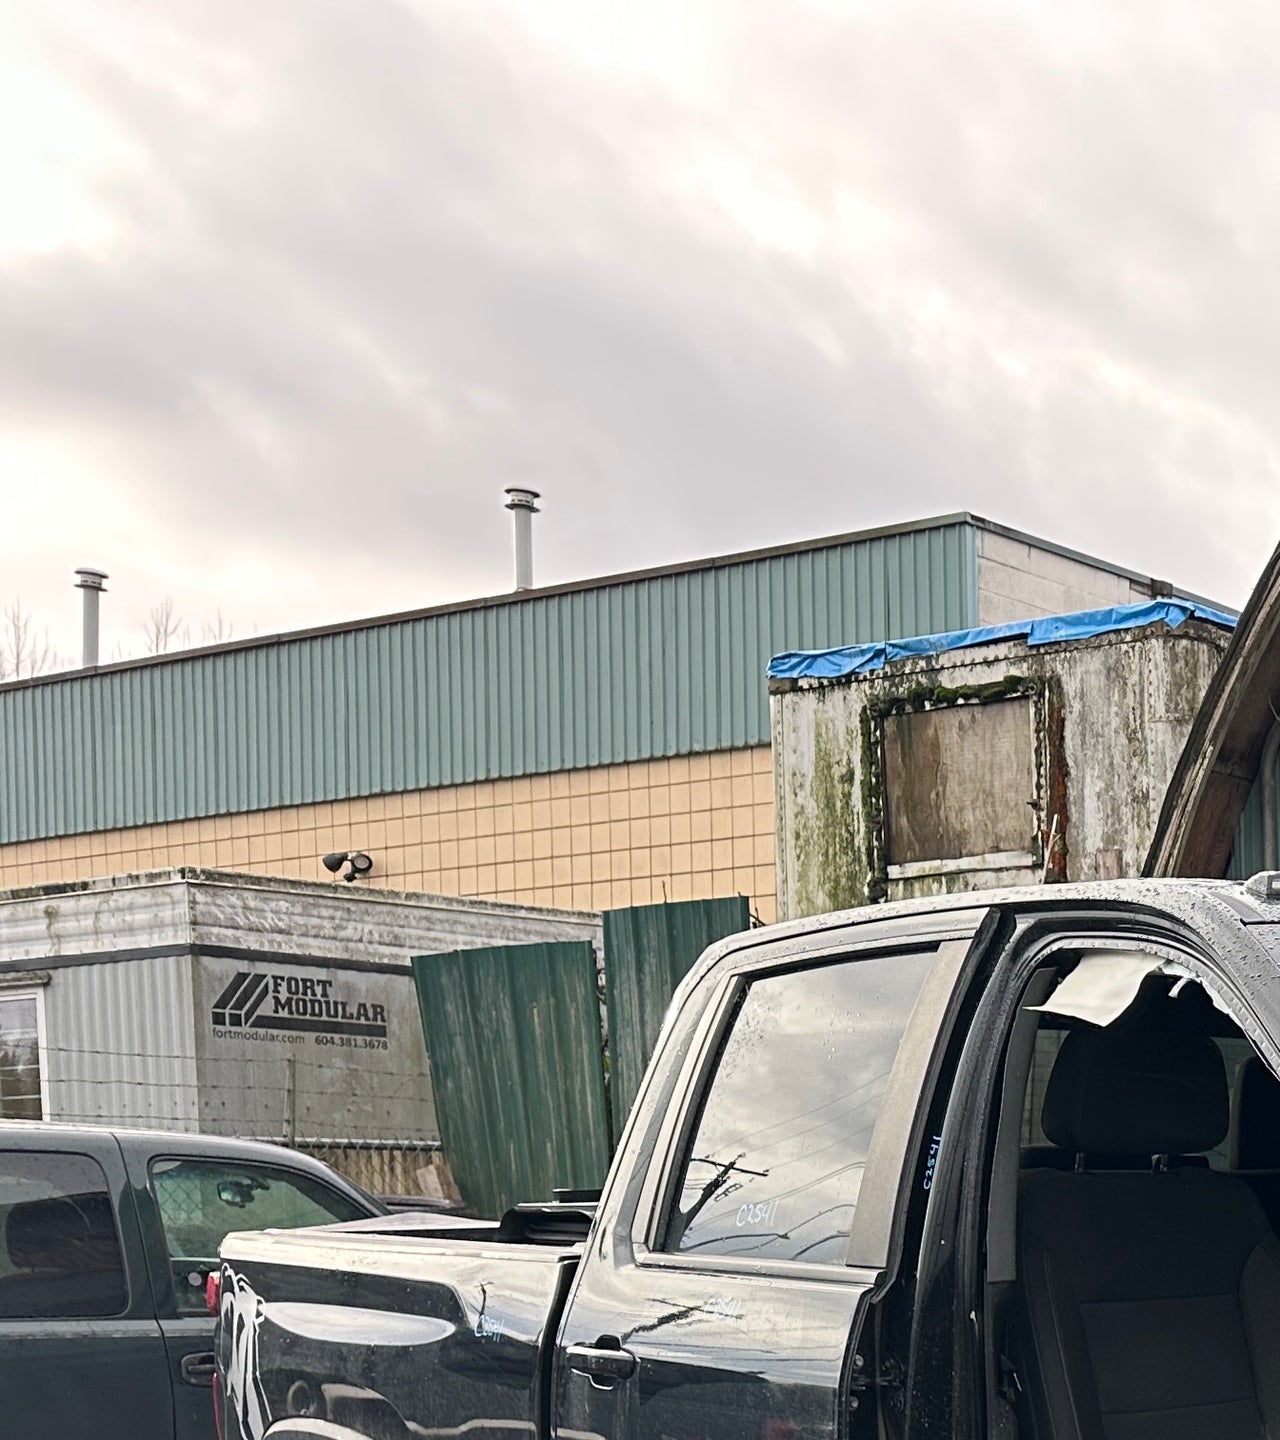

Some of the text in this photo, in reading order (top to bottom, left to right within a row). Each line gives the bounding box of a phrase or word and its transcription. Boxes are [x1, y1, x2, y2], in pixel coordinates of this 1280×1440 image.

[271, 975, 332, 998] FORT
[273, 996, 387, 1023] MODULAR
[212, 1027, 389, 1050] fortmodular.com 604.381.3678
